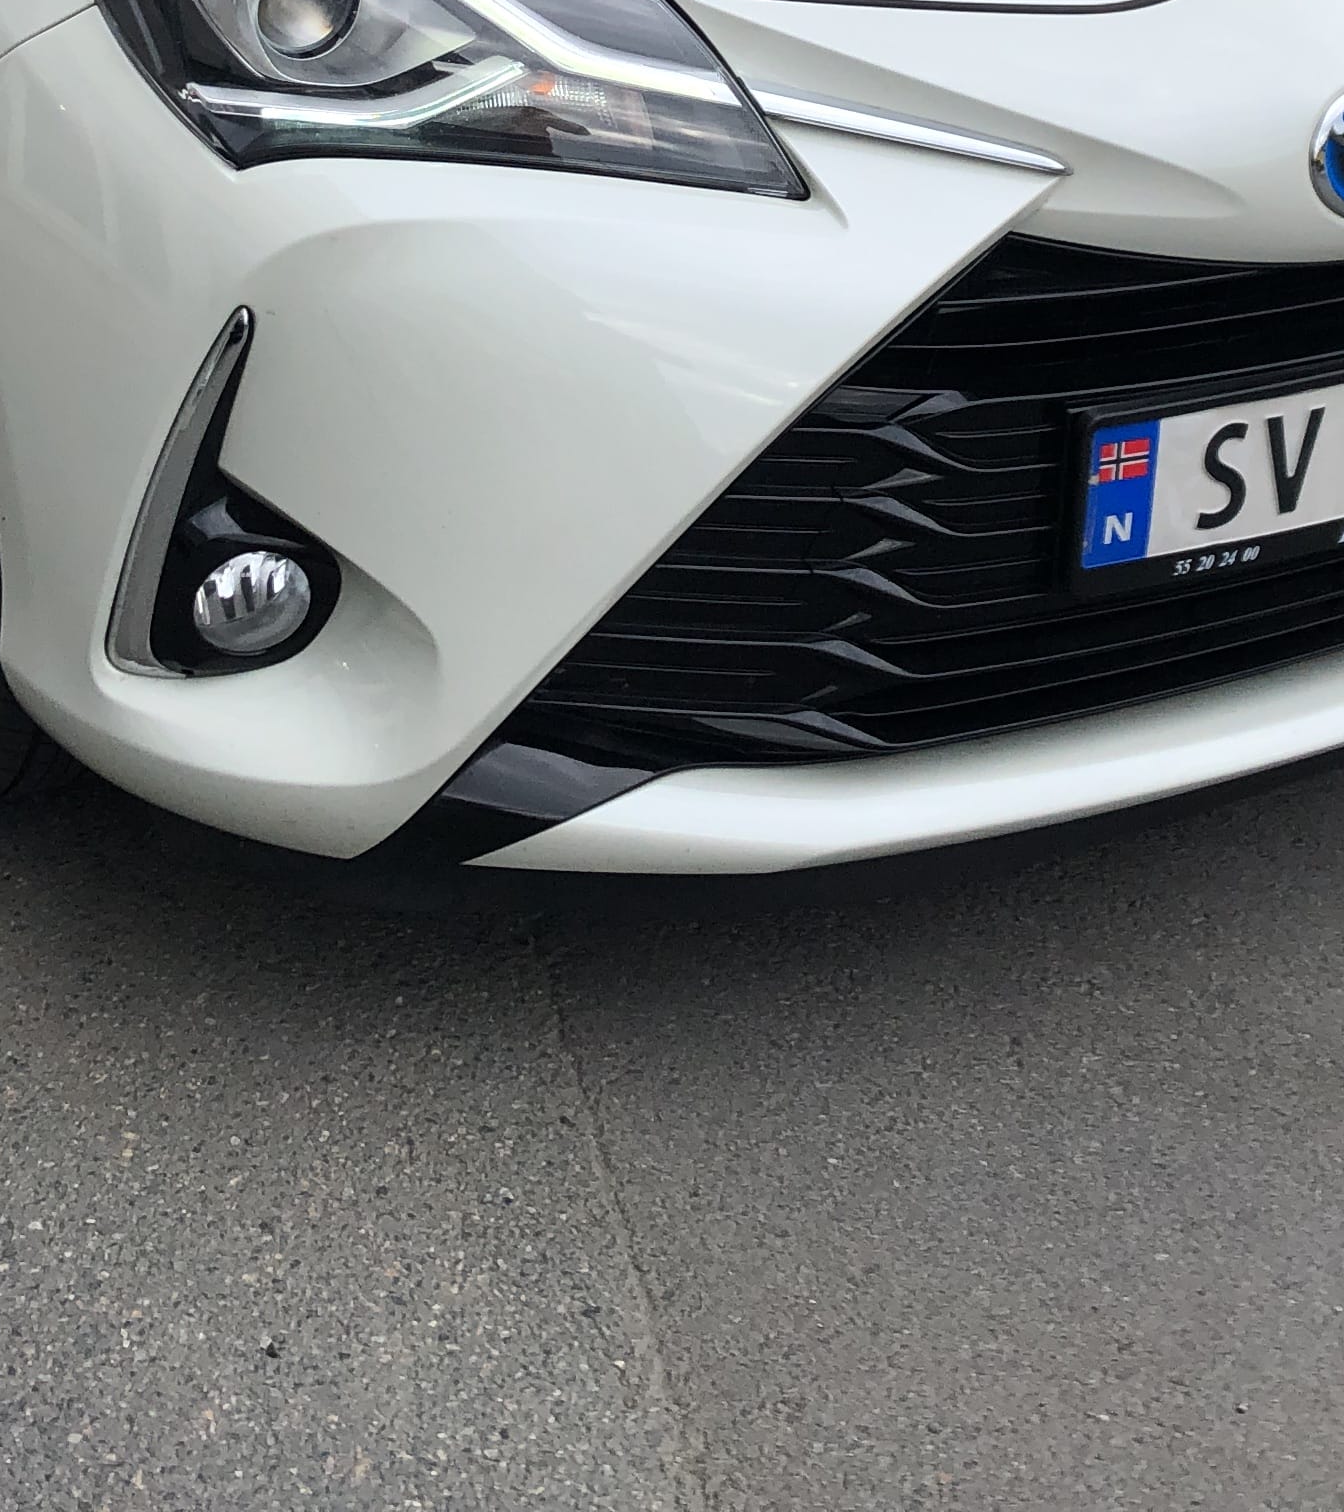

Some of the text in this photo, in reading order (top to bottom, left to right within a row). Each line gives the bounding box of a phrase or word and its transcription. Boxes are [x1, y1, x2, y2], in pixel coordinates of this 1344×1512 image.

[1195, 406, 1326, 531] SV
[1103, 512, 1133, 545] N
[1171, 545, 1261, 576] 55 20 24 00
